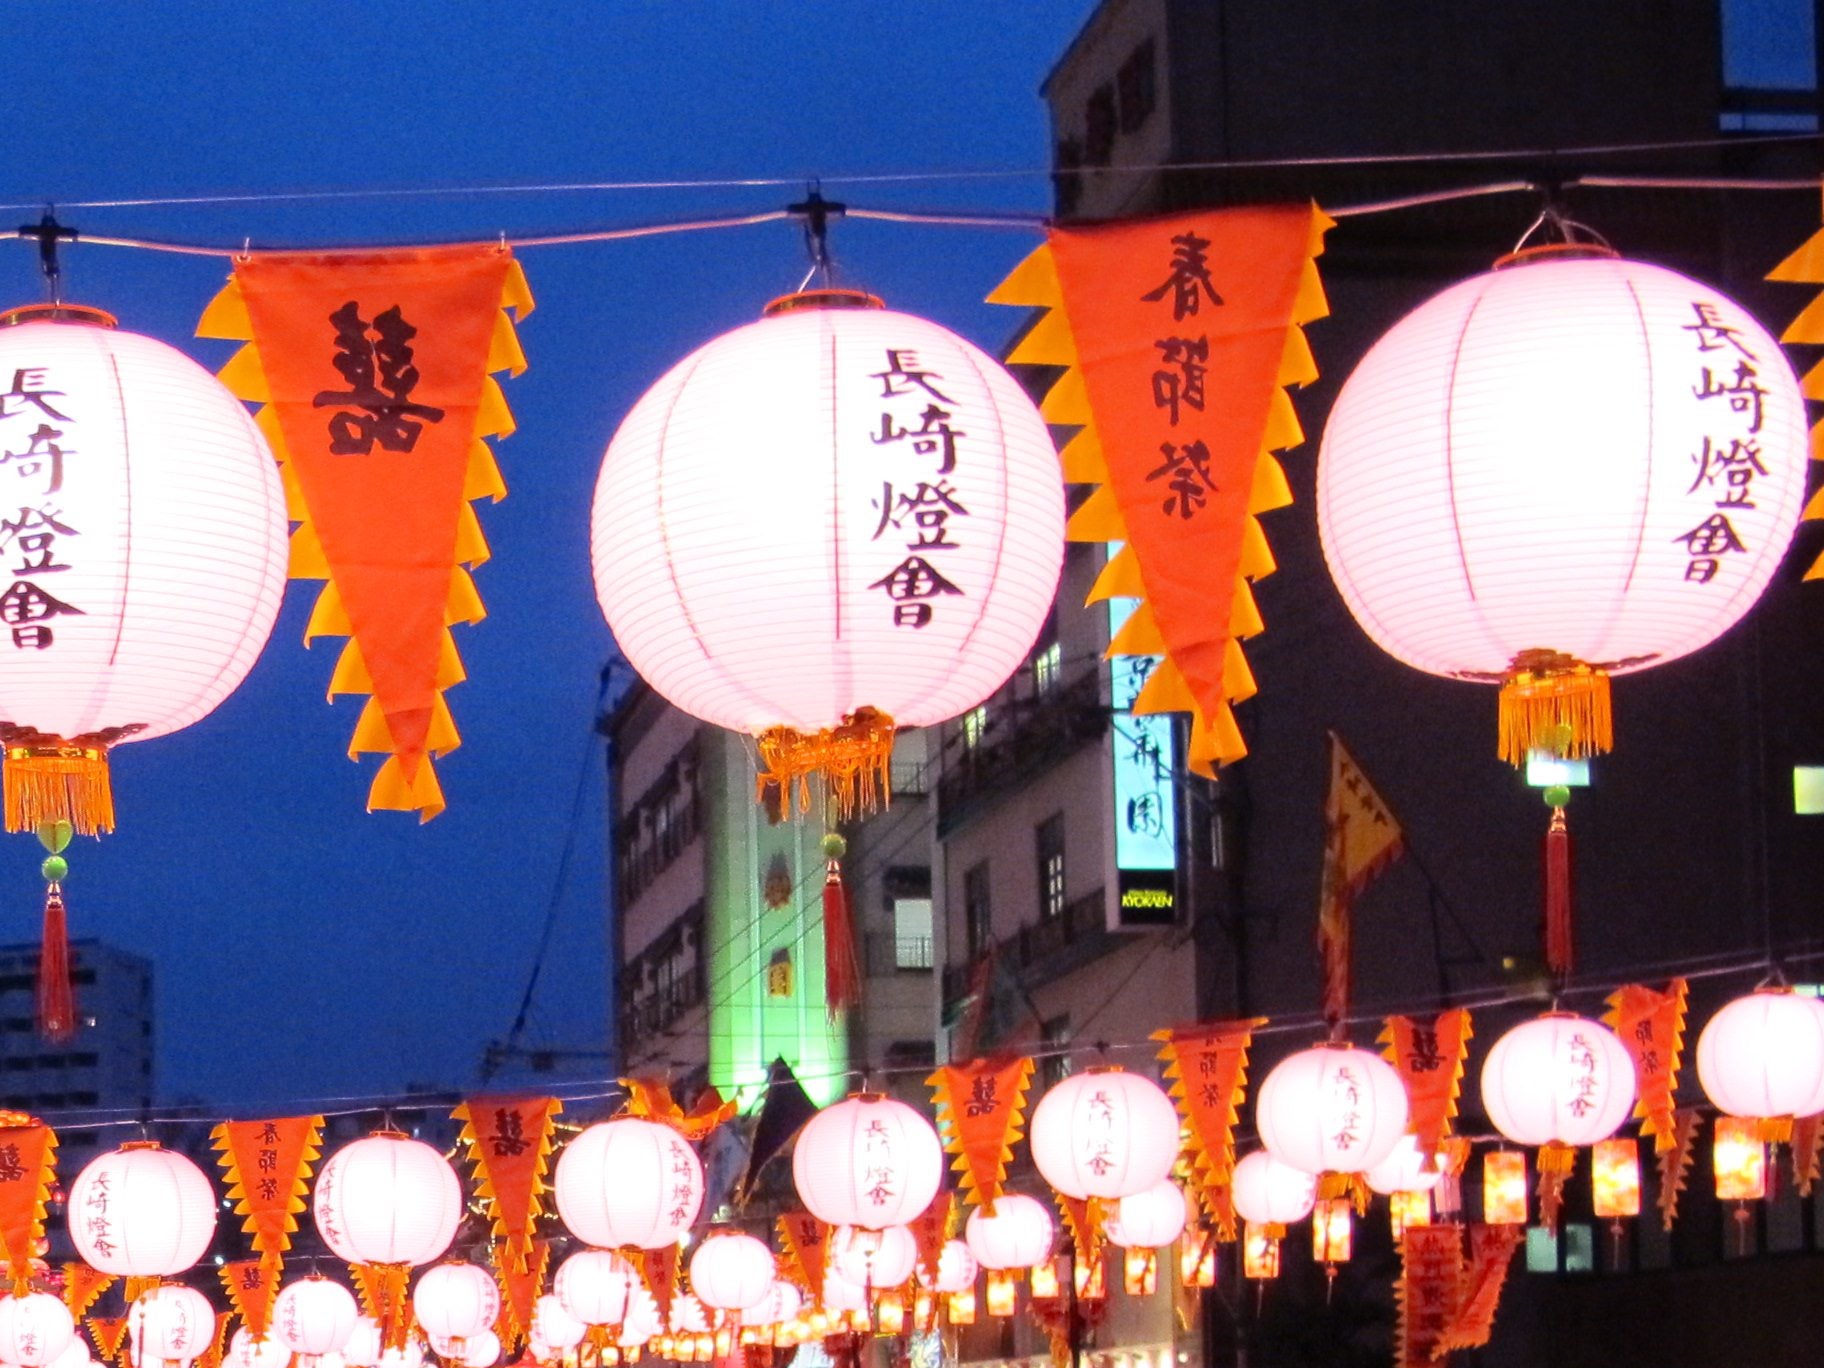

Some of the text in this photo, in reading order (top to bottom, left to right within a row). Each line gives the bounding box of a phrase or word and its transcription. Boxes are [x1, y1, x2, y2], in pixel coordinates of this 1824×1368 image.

[866, 348, 971, 629] 長崎燈會
[1671, 301, 1771, 584] 長崎燈會
